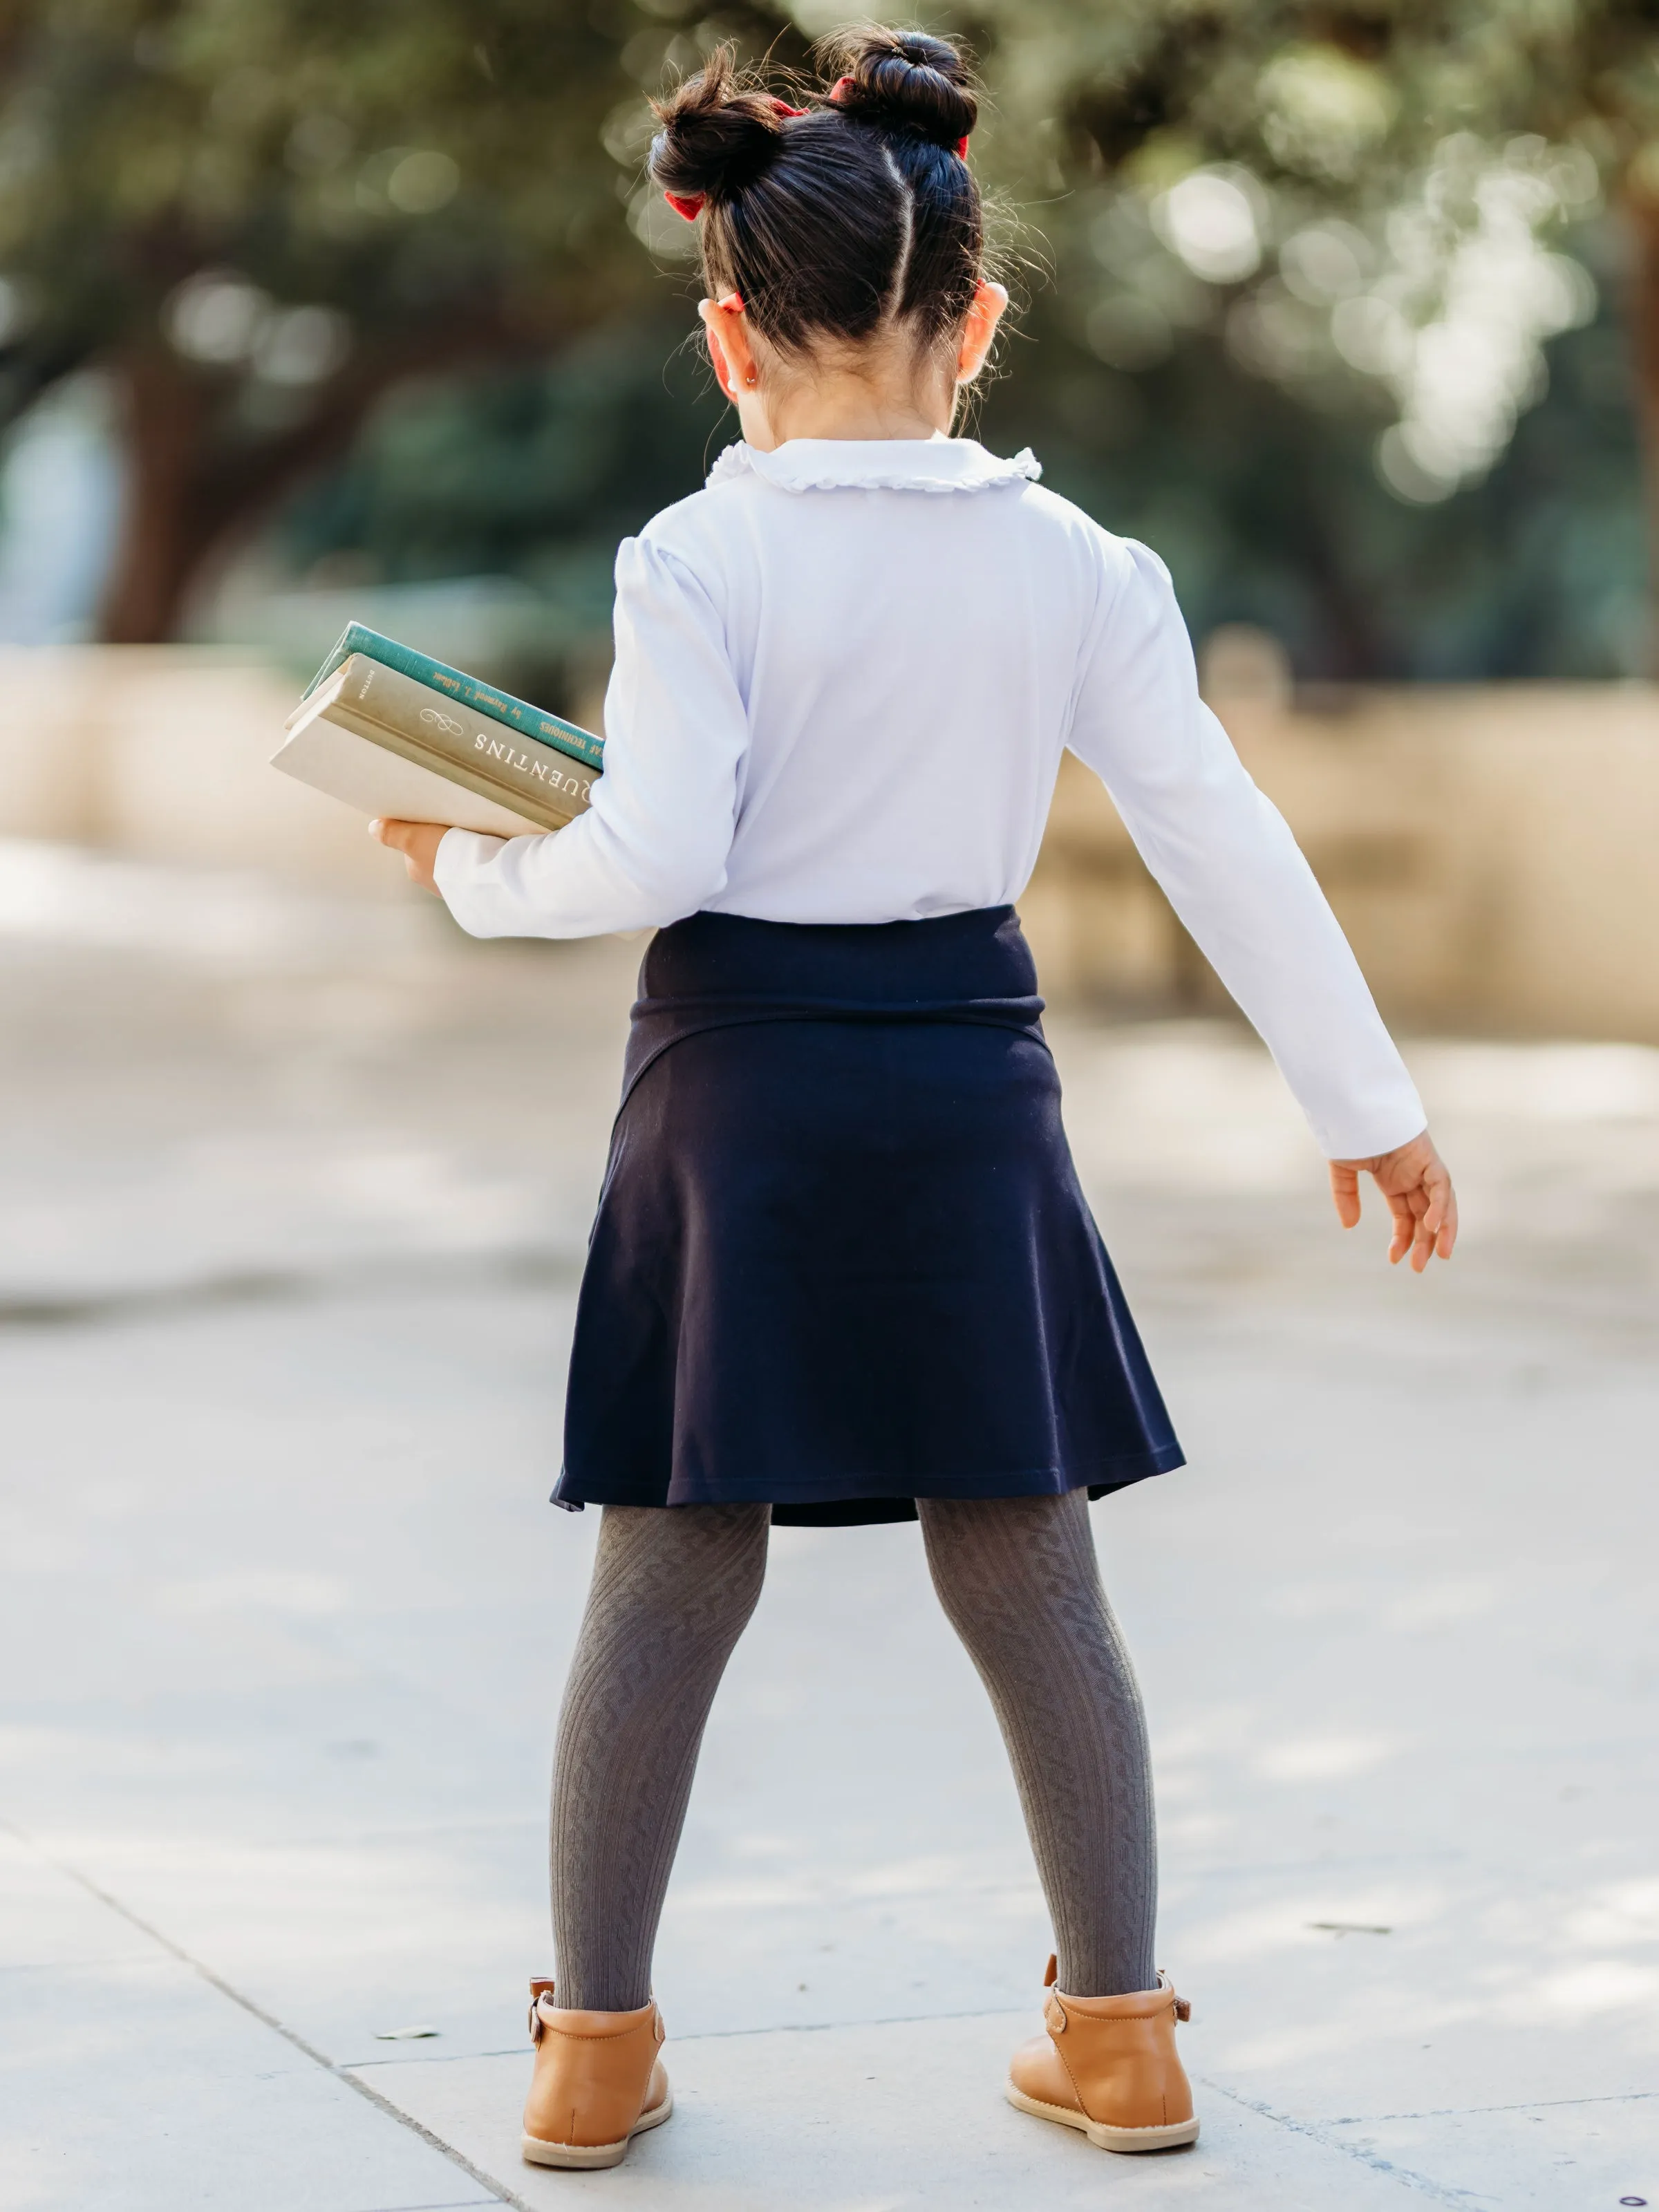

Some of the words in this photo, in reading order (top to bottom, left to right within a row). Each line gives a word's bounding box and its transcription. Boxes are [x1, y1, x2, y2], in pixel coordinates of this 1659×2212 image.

[358, 668, 375, 700] DUTTON
[473, 691, 508, 714] Raymond
[512, 706, 523, 720] by
[540, 721, 587, 749] TECHNIQUES
[474, 733, 592, 803] QUENTINS
